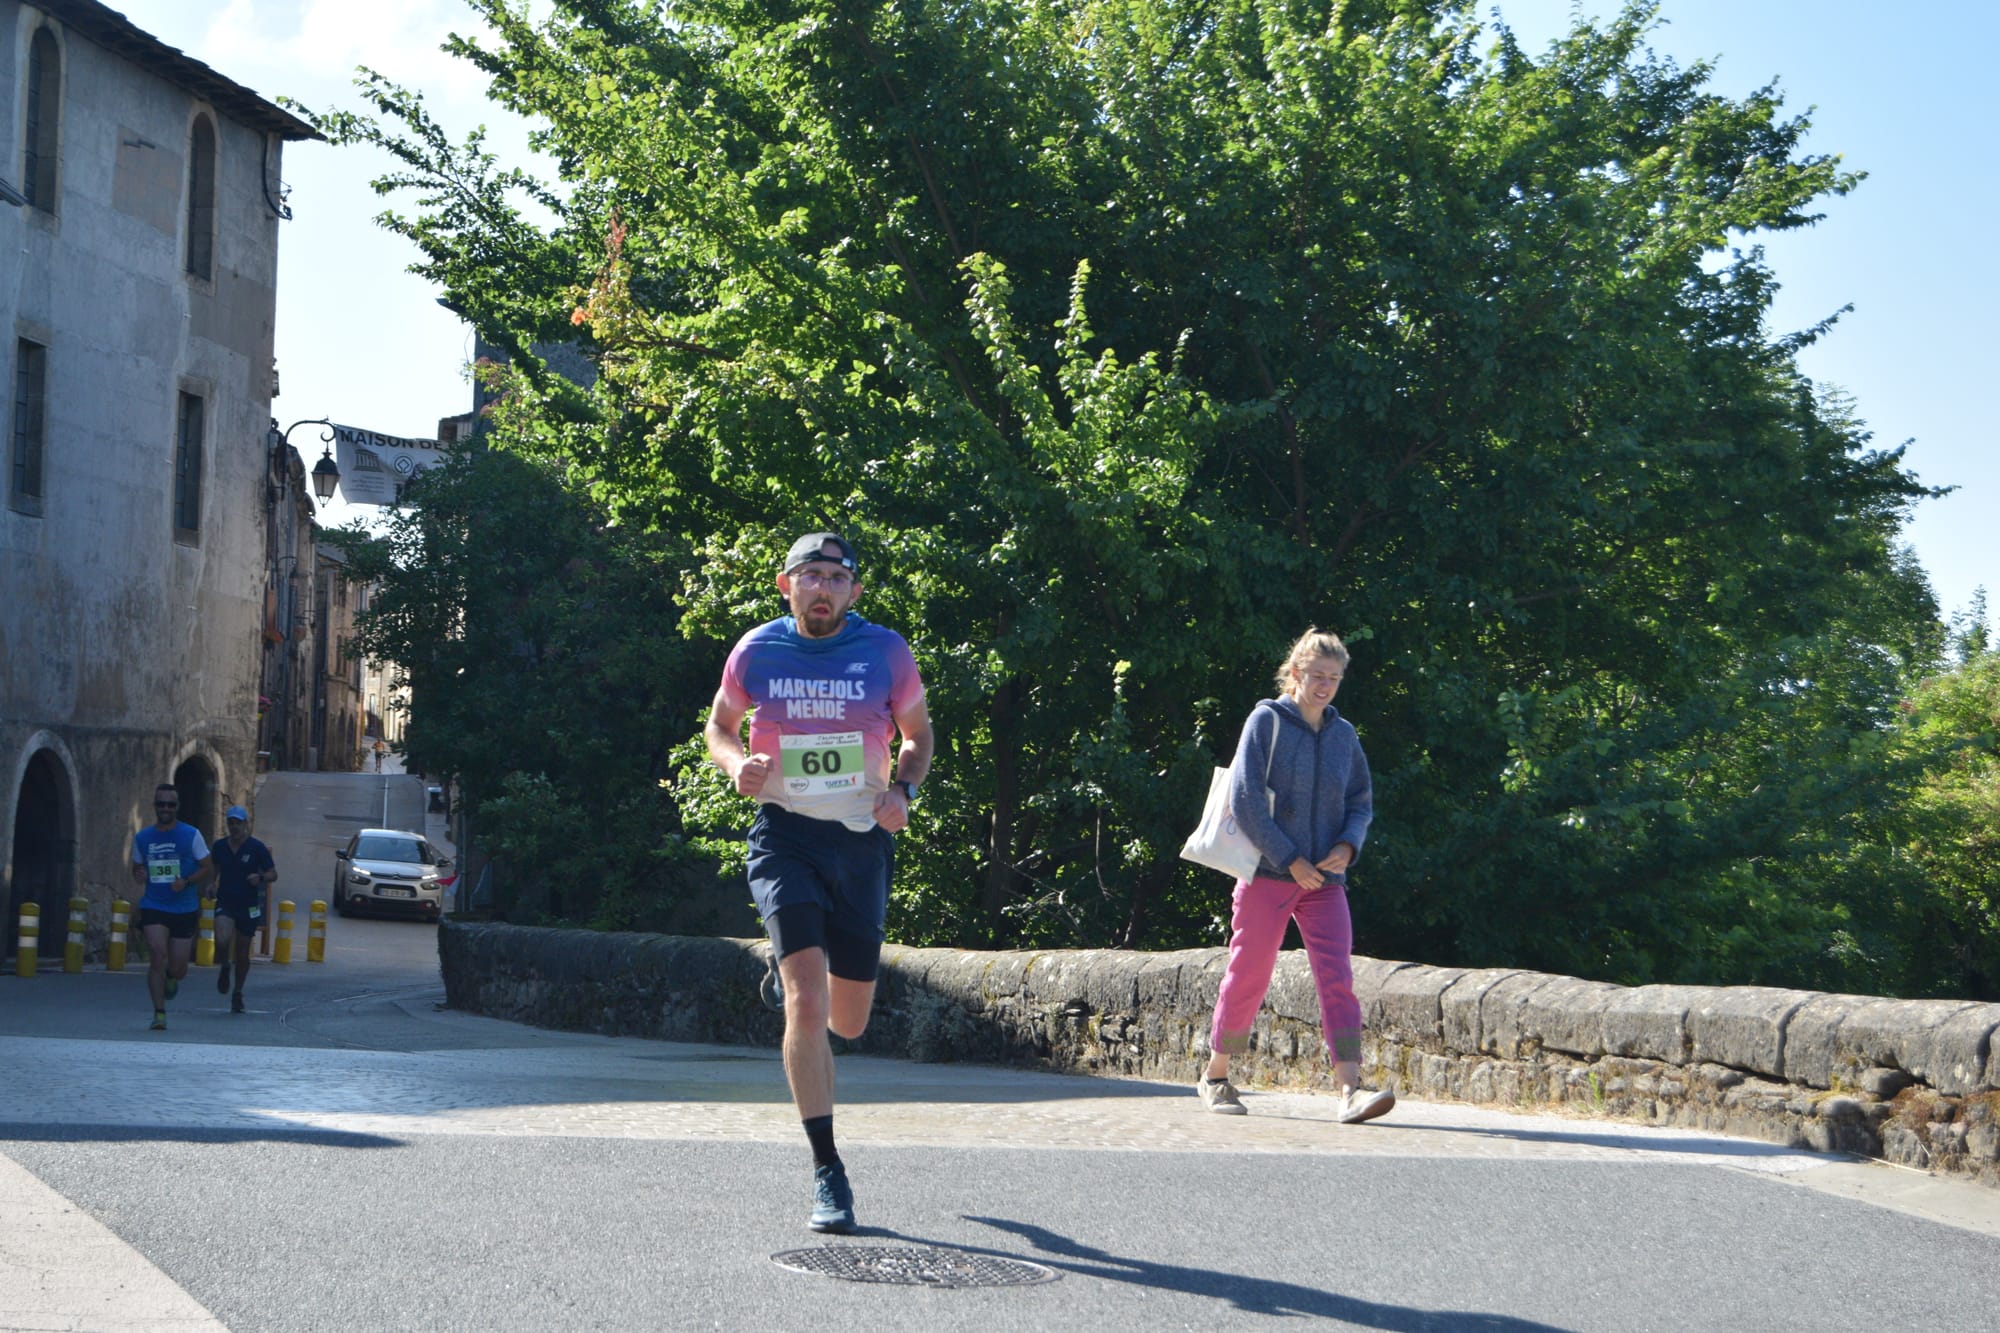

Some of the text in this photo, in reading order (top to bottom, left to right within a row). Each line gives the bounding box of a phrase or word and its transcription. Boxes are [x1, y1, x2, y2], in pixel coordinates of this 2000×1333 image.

[340, 430, 414, 449] MAISON
[768, 678, 865, 700] MARVEJOLS
[786, 699, 846, 720] MENDE
[801, 750, 842, 775] 60
[156, 865, 172, 876] 38
